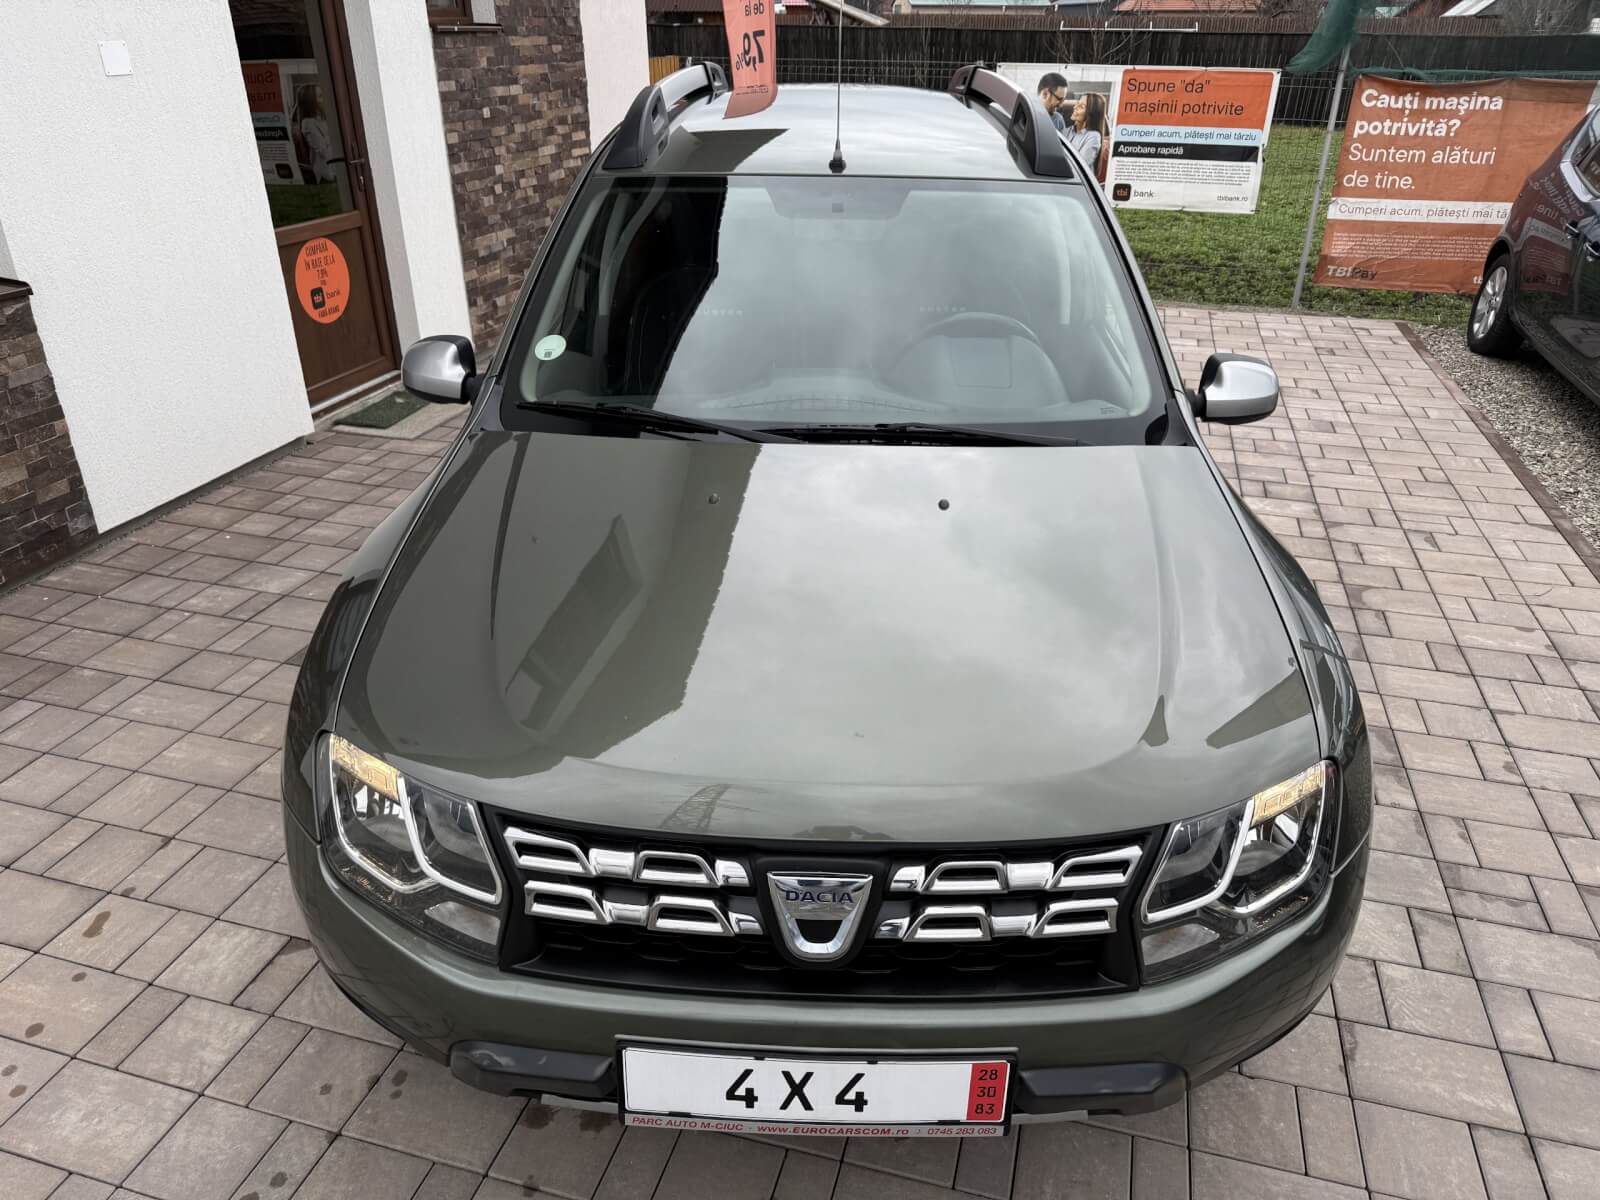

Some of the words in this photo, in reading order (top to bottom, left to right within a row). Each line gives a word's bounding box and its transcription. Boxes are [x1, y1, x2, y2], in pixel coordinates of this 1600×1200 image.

[1127, 78, 1176, 94] Spune
[1180, 79, 1211, 94] "da"
[1124, 99, 1178, 117] mașinii
[1181, 101, 1244, 117] potrivite
[1361, 88, 1420, 116] Cauți
[1120, 128, 1156, 139] Cumperi
[1216, 131, 1232, 140] mai
[1353, 117, 1462, 139] potrivită?
[1118, 144, 1157, 155] Aprobare
[1348, 143, 1426, 164] Suntem
[1431, 146, 1497, 165] alături
[1343, 170, 1369, 188] de
[1374, 171, 1416, 190] tine.
[1133, 190, 1154, 198] bank
[1338, 203, 1387, 217] Cumperi
[1472, 207, 1494, 218] mai
[785, 890, 853, 903] DACIA
[978, 1069, 998, 1081] 28
[725, 1069, 758, 1108] 4
[779, 1071, 814, 1111] X
[835, 1073, 868, 1112] 4
[976, 1086, 996, 1098] 30
[974, 1103, 994, 1114] 83
[632, 1117, 662, 1126] PARC
[665, 1120, 697, 1129] AUTO
[699, 1121, 744, 1131] M-CIUC
[927, 1127, 952, 1136] 0745
[955, 1127, 974, 1136] 283
[977, 1127, 997, 1136] 083
